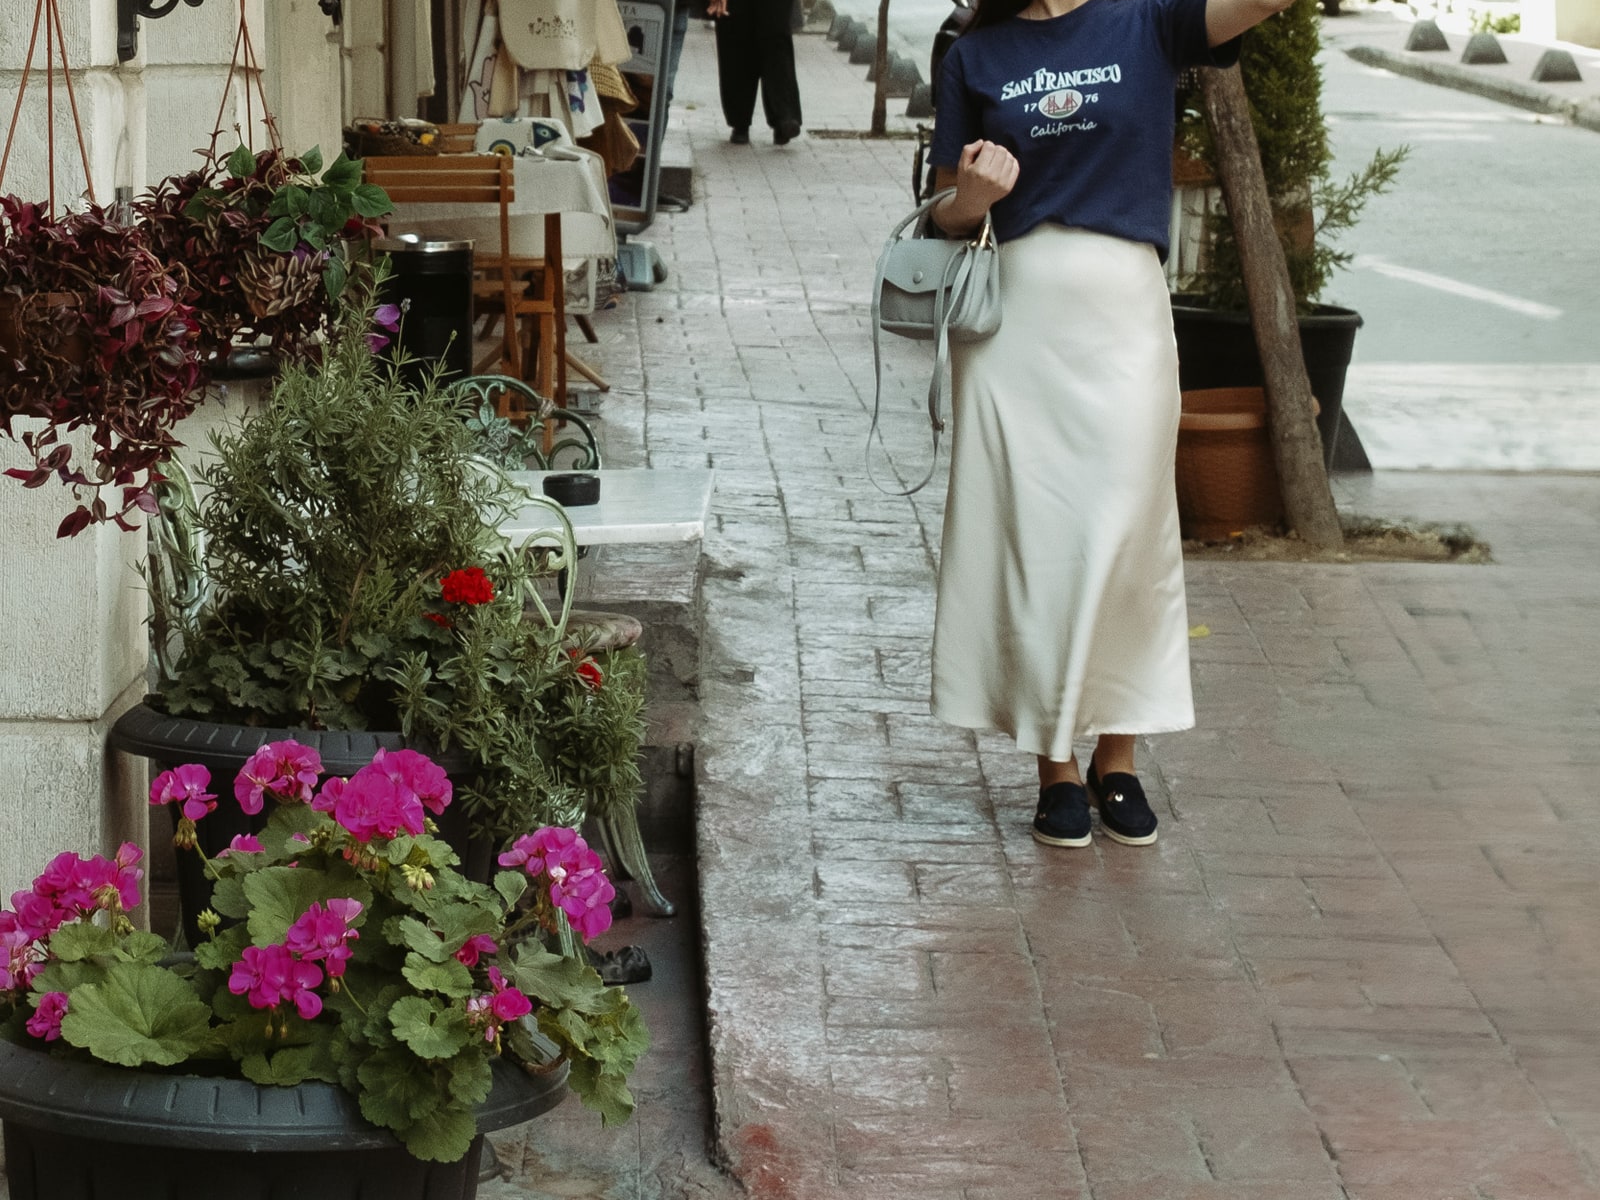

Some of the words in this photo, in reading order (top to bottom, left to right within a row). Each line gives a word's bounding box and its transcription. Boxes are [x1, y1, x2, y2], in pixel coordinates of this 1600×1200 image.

[1001, 77, 1033, 100] SAN
[1034, 63, 1121, 91] FRANCISCO
[1023, 102, 1038, 113] 17
[1084, 92, 1099, 104] 76
[1031, 118, 1097, 137] California
